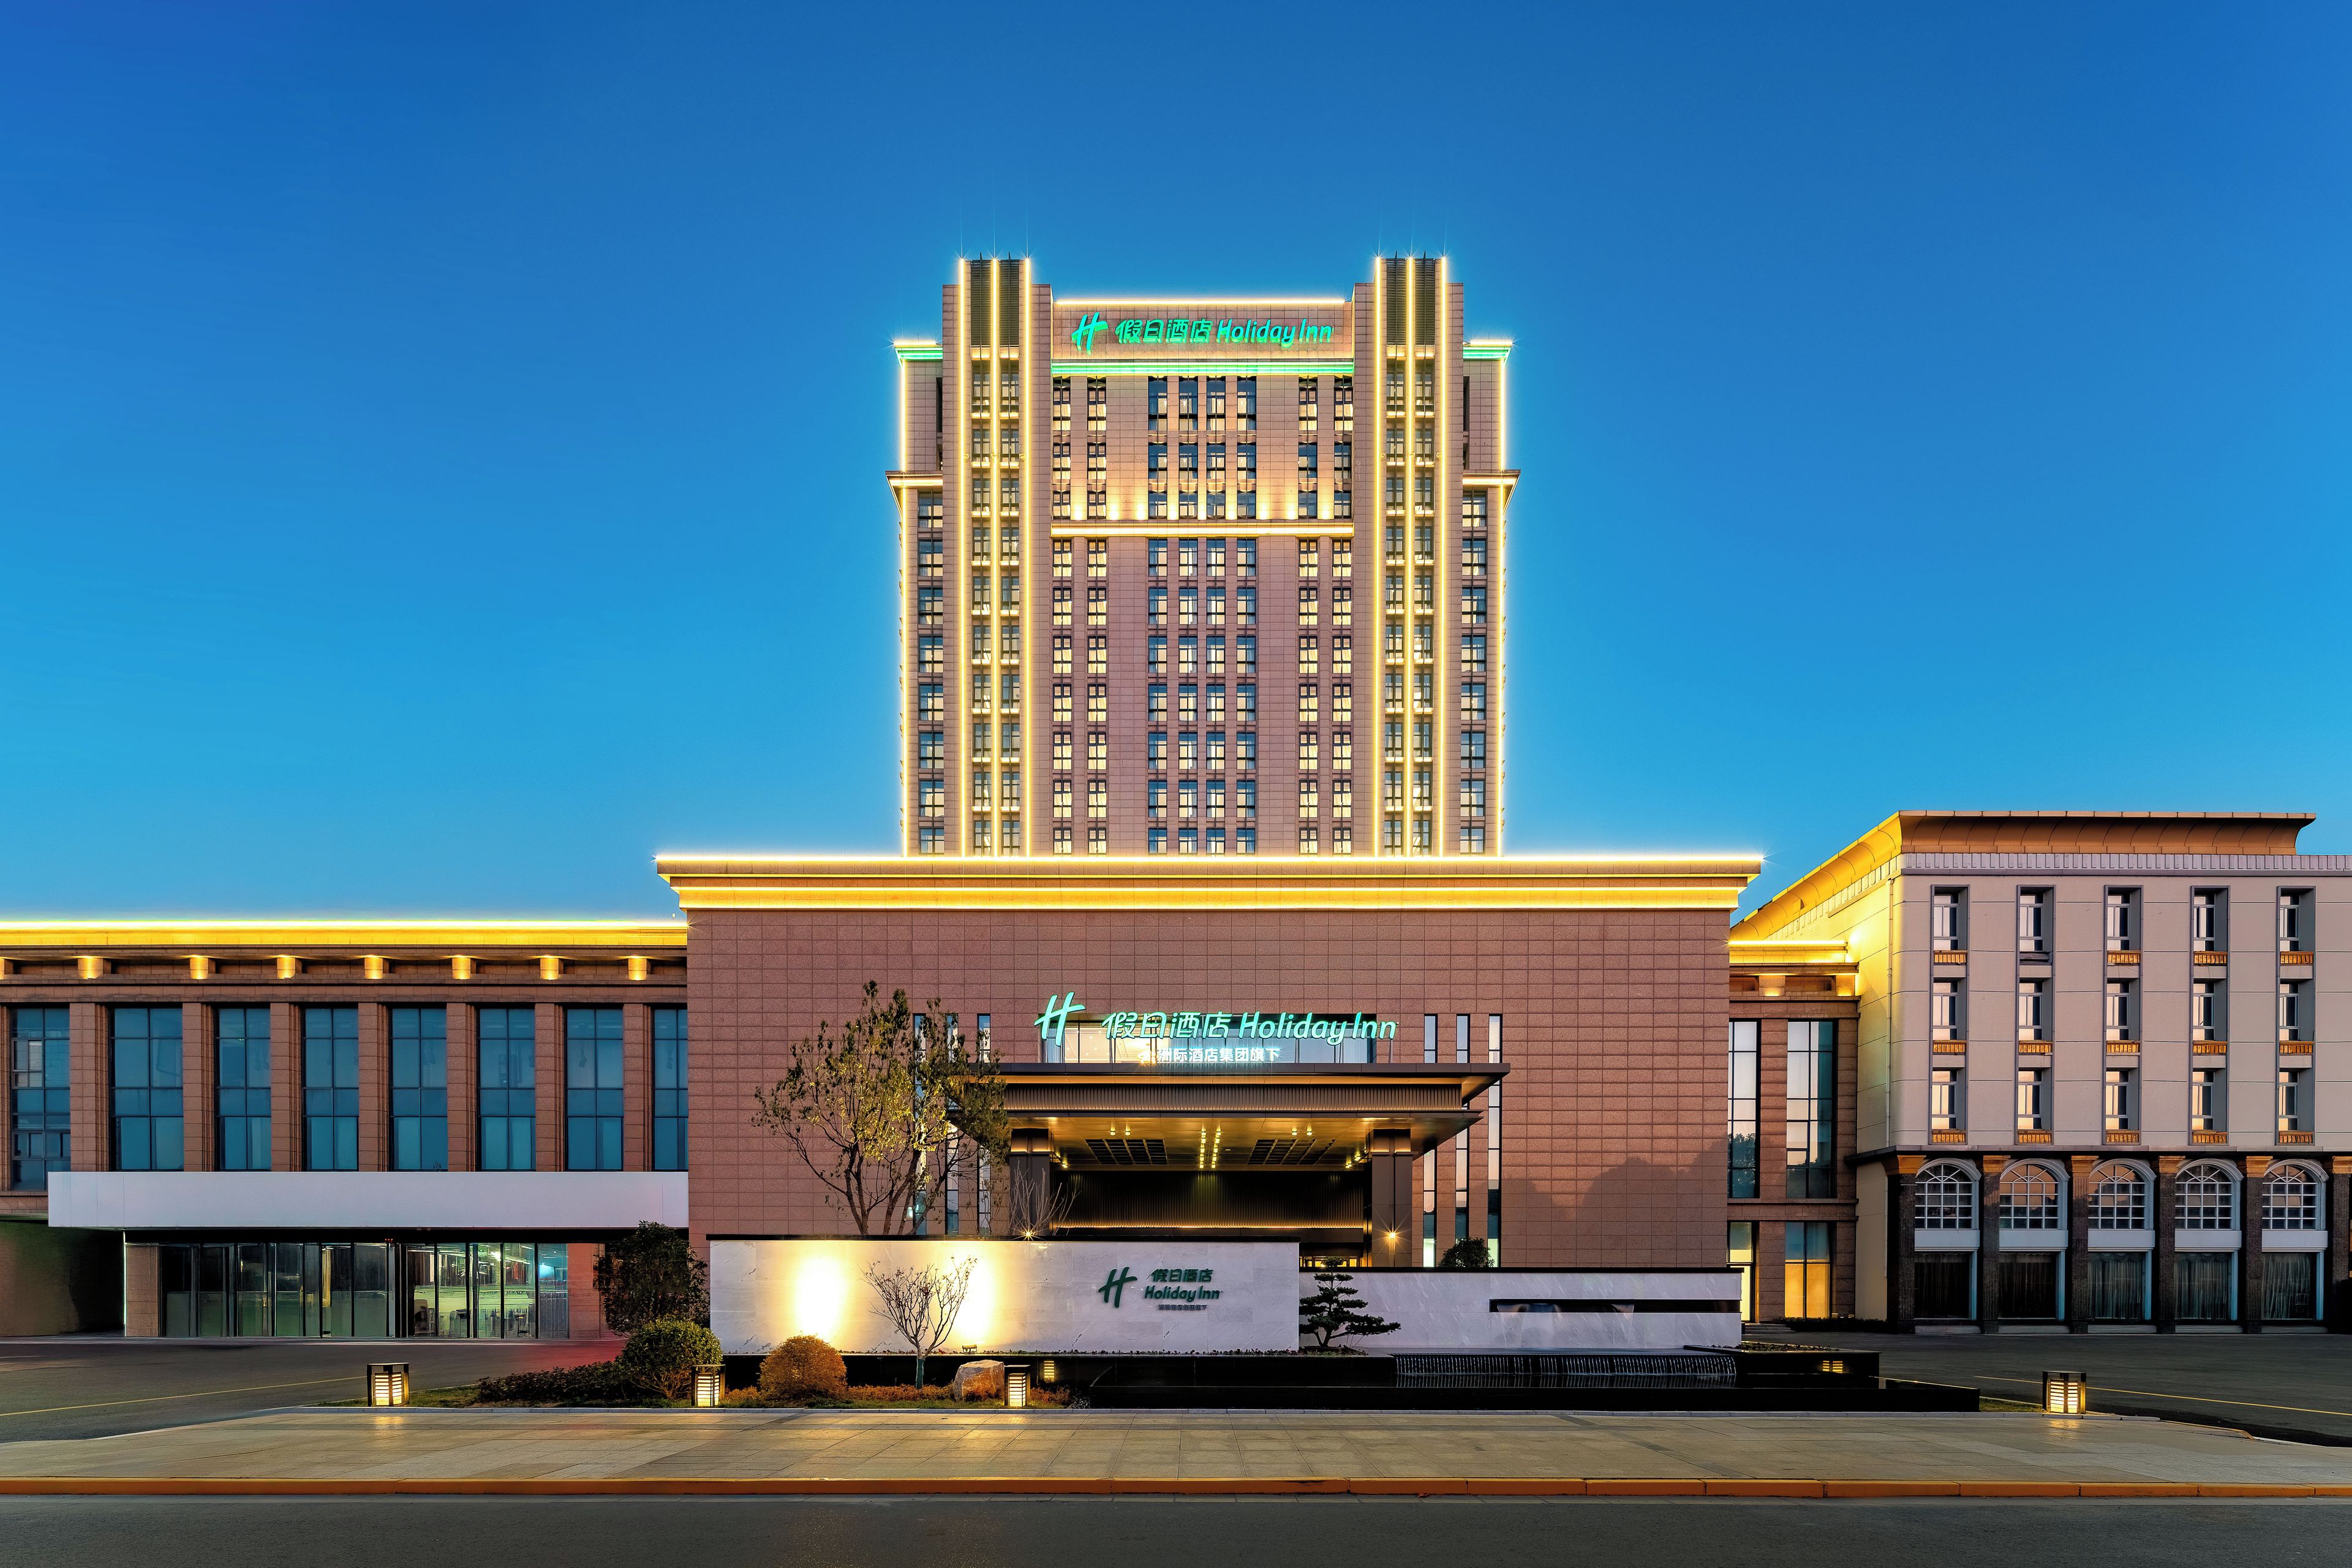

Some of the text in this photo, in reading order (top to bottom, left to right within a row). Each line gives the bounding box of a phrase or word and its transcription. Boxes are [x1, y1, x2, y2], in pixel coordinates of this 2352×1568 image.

[1115, 318, 1213, 344] 假日酒店
[1216, 318, 1333, 348] Holiday Inn
[1102, 1011, 1231, 1039] 假日酒店
[1238, 1011, 1397, 1046] Holiday Inn
[1152, 1268, 1214, 1283] 假日酒店
[1144, 1285, 1219, 1302] Holiday Inn
